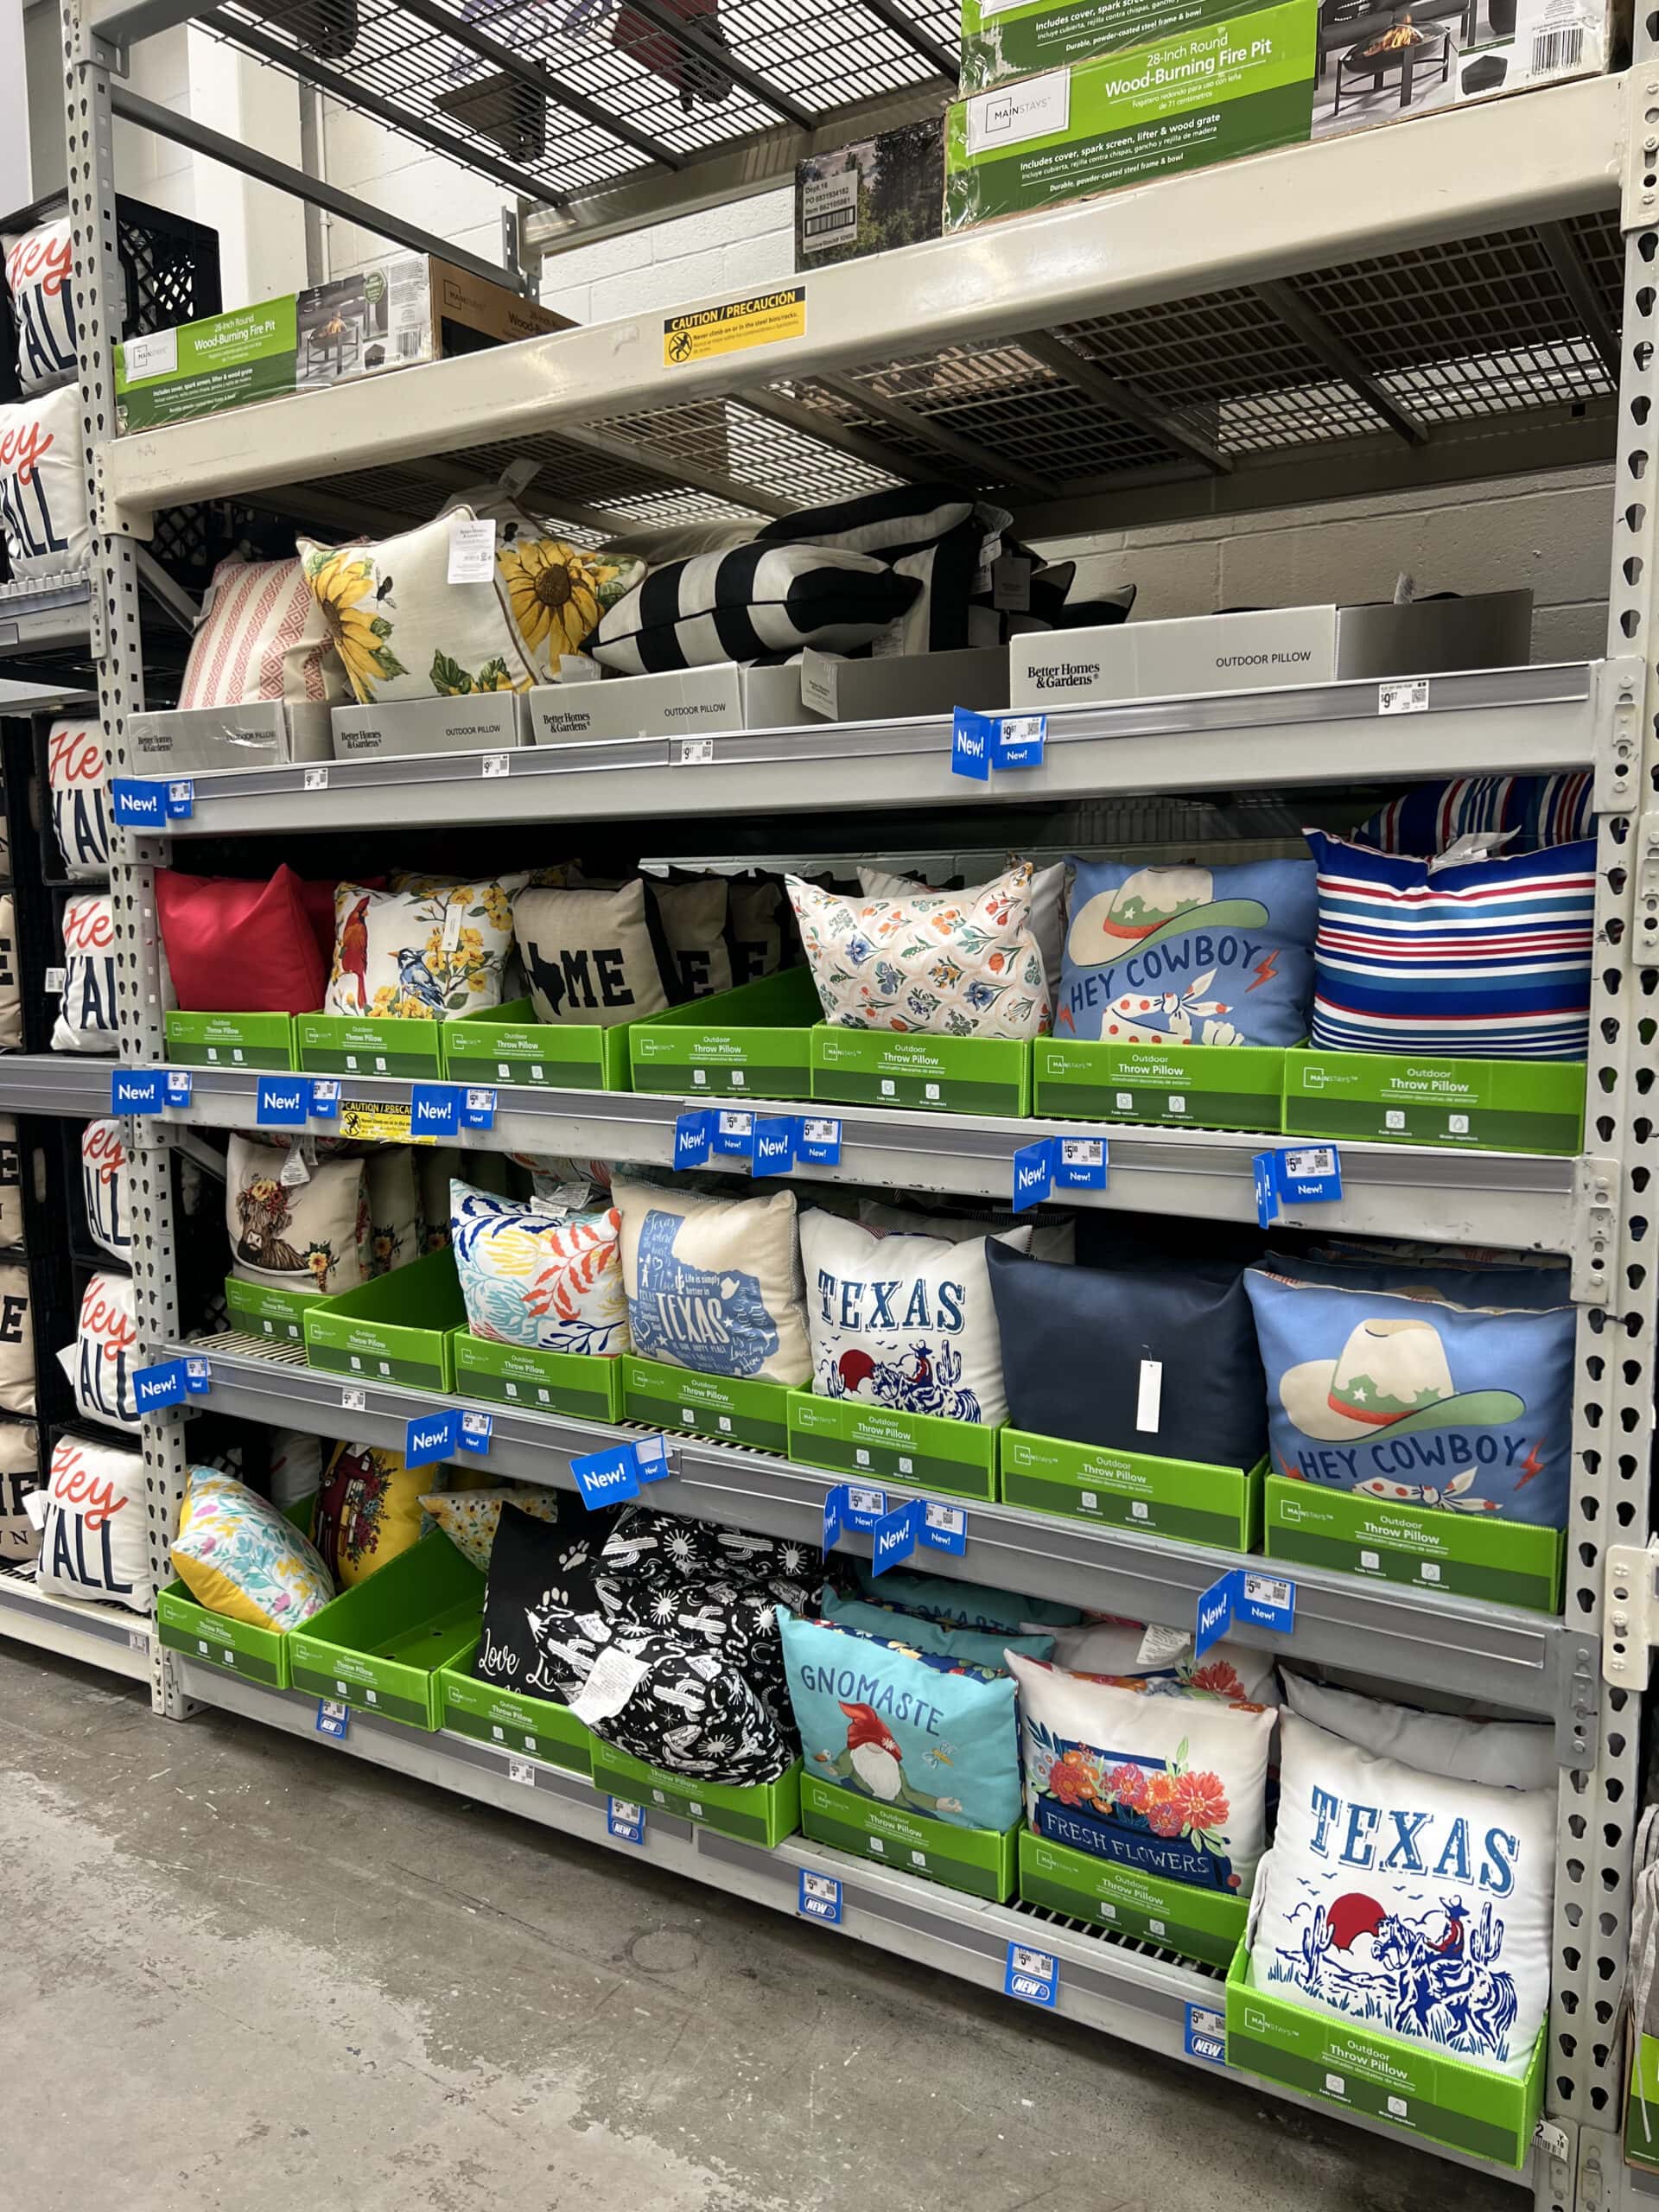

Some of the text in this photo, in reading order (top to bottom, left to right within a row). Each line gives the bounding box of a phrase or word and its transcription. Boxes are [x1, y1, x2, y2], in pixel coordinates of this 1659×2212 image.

[1036, 0, 1122, 31] Includes cover, spark
[1147, 32, 1230, 67] 28-Inch Round
[1105, 38, 1273, 98] Wood-Burning Fire Pit
[1020, 113, 1221, 171] Includes cover, spark screen, lifter & wood grate
[7, 237, 73, 296] Hey
[671, 290, 796, 332] CAUTION / PRECAUCIÓN
[194, 320, 276, 351] Wood-Burning Fire Pit
[0, 421, 54, 486] ey
[1215, 650, 1312, 669] OUTDOOR PILLOW
[1027, 663, 1101, 678] Better Homes
[1036, 674, 1093, 689] & Gardens
[543, 711, 592, 725] Better Homes
[664, 702, 727, 717] OUTDOOR PILLOW
[340, 729, 382, 742] Better Homes
[445, 724, 501, 737] OUTDOOR PILLOW
[550, 720, 588, 734] & Gardens
[957, 728, 984, 759] New!
[49, 731, 105, 788] He
[1007, 749, 1028, 760] New!
[120, 794, 158, 811] New!
[65, 901, 116, 949] He
[1071, 934, 1262, 1014] HEY COWBOY
[504, 1032, 528, 1041] Outdoor
[703, 1036, 730, 1045] Outdoor
[496, 1039, 539, 1052] Throw Pillow
[693, 1043, 742, 1055] Throw Pillow
[894, 1044, 927, 1053] Outdoor
[883, 1052, 940, 1066] Throw Pillow
[1132, 1054, 1169, 1064] Outdoor
[1118, 1063, 1184, 1077] Throw Pillow
[1407, 1067, 1452, 1079] Outdoor
[118, 1084, 155, 1100] New!
[1389, 1078, 1469, 1093] Throw Pillow
[264, 1092, 300, 1109] New!
[417, 1101, 453, 1120] New!
[679, 1127, 706, 1152] New!
[724, 1139, 741, 1149] New!
[759, 1135, 788, 1158] New!
[809, 1148, 827, 1158] New!
[1019, 1159, 1046, 1191] New!
[1070, 1171, 1091, 1181] New!
[1297, 1183, 1324, 1195] New!
[702, 1274, 720, 1286] simply
[817, 1268, 966, 1336] TEXAS
[655, 1292, 731, 1344] TEXAS
[504, 1360, 545, 1375] Throw Pillow
[512, 1354, 534, 1364] Outdoor
[141, 1374, 177, 1399] New!
[691, 1379, 718, 1390] Outdoor
[682, 1385, 729, 1402] Throw Pillow
[868, 1416, 899, 1427] Outdoor
[413, 1426, 448, 1452] New!
[857, 1422, 912, 1441] Throw Pillow
[1096, 1456, 1132, 1471] Outdoor
[1297, 1433, 1527, 1480] HEY COWBOY
[582, 1462, 627, 1492] New!
[1083, 1463, 1147, 1484] Throw Pillow
[51, 1446, 130, 1531] Hey
[855, 1516, 874, 1528] New!
[1380, 1515, 1424, 1530] Outdoor
[879, 1519, 910, 1555] New!
[931, 1532, 951, 1546] New!
[1363, 1521, 1440, 1546] Throw Pillow
[1201, 1592, 1227, 1635] New!
[1251, 1605, 1275, 1622] New!
[479, 1628, 520, 1676] Love
[800, 1664, 944, 1731] GNOMASTE
[491, 1703, 533, 1724] Throw Pillow
[869, 1814, 923, 1839] Throw Pillow
[880, 1810, 910, 1826] Outdoor
[613, 1821, 632, 1836] NEW
[1046, 1810, 1211, 1874] FRESH FLOWERS
[1308, 1784, 1521, 1899] TEXAS
[1115, 1874, 1149, 1891] Outdoor
[1103, 1878, 1164, 1906] Throw Pillow
[806, 1898, 827, 1915] NEW
[1014, 1978, 1041, 1997] NEW
[1194, 2040, 1224, 2058] NEW
[1346, 2038, 1390, 2062] Outdoor
[1330, 2044, 1409, 2081] Throw Pillow
